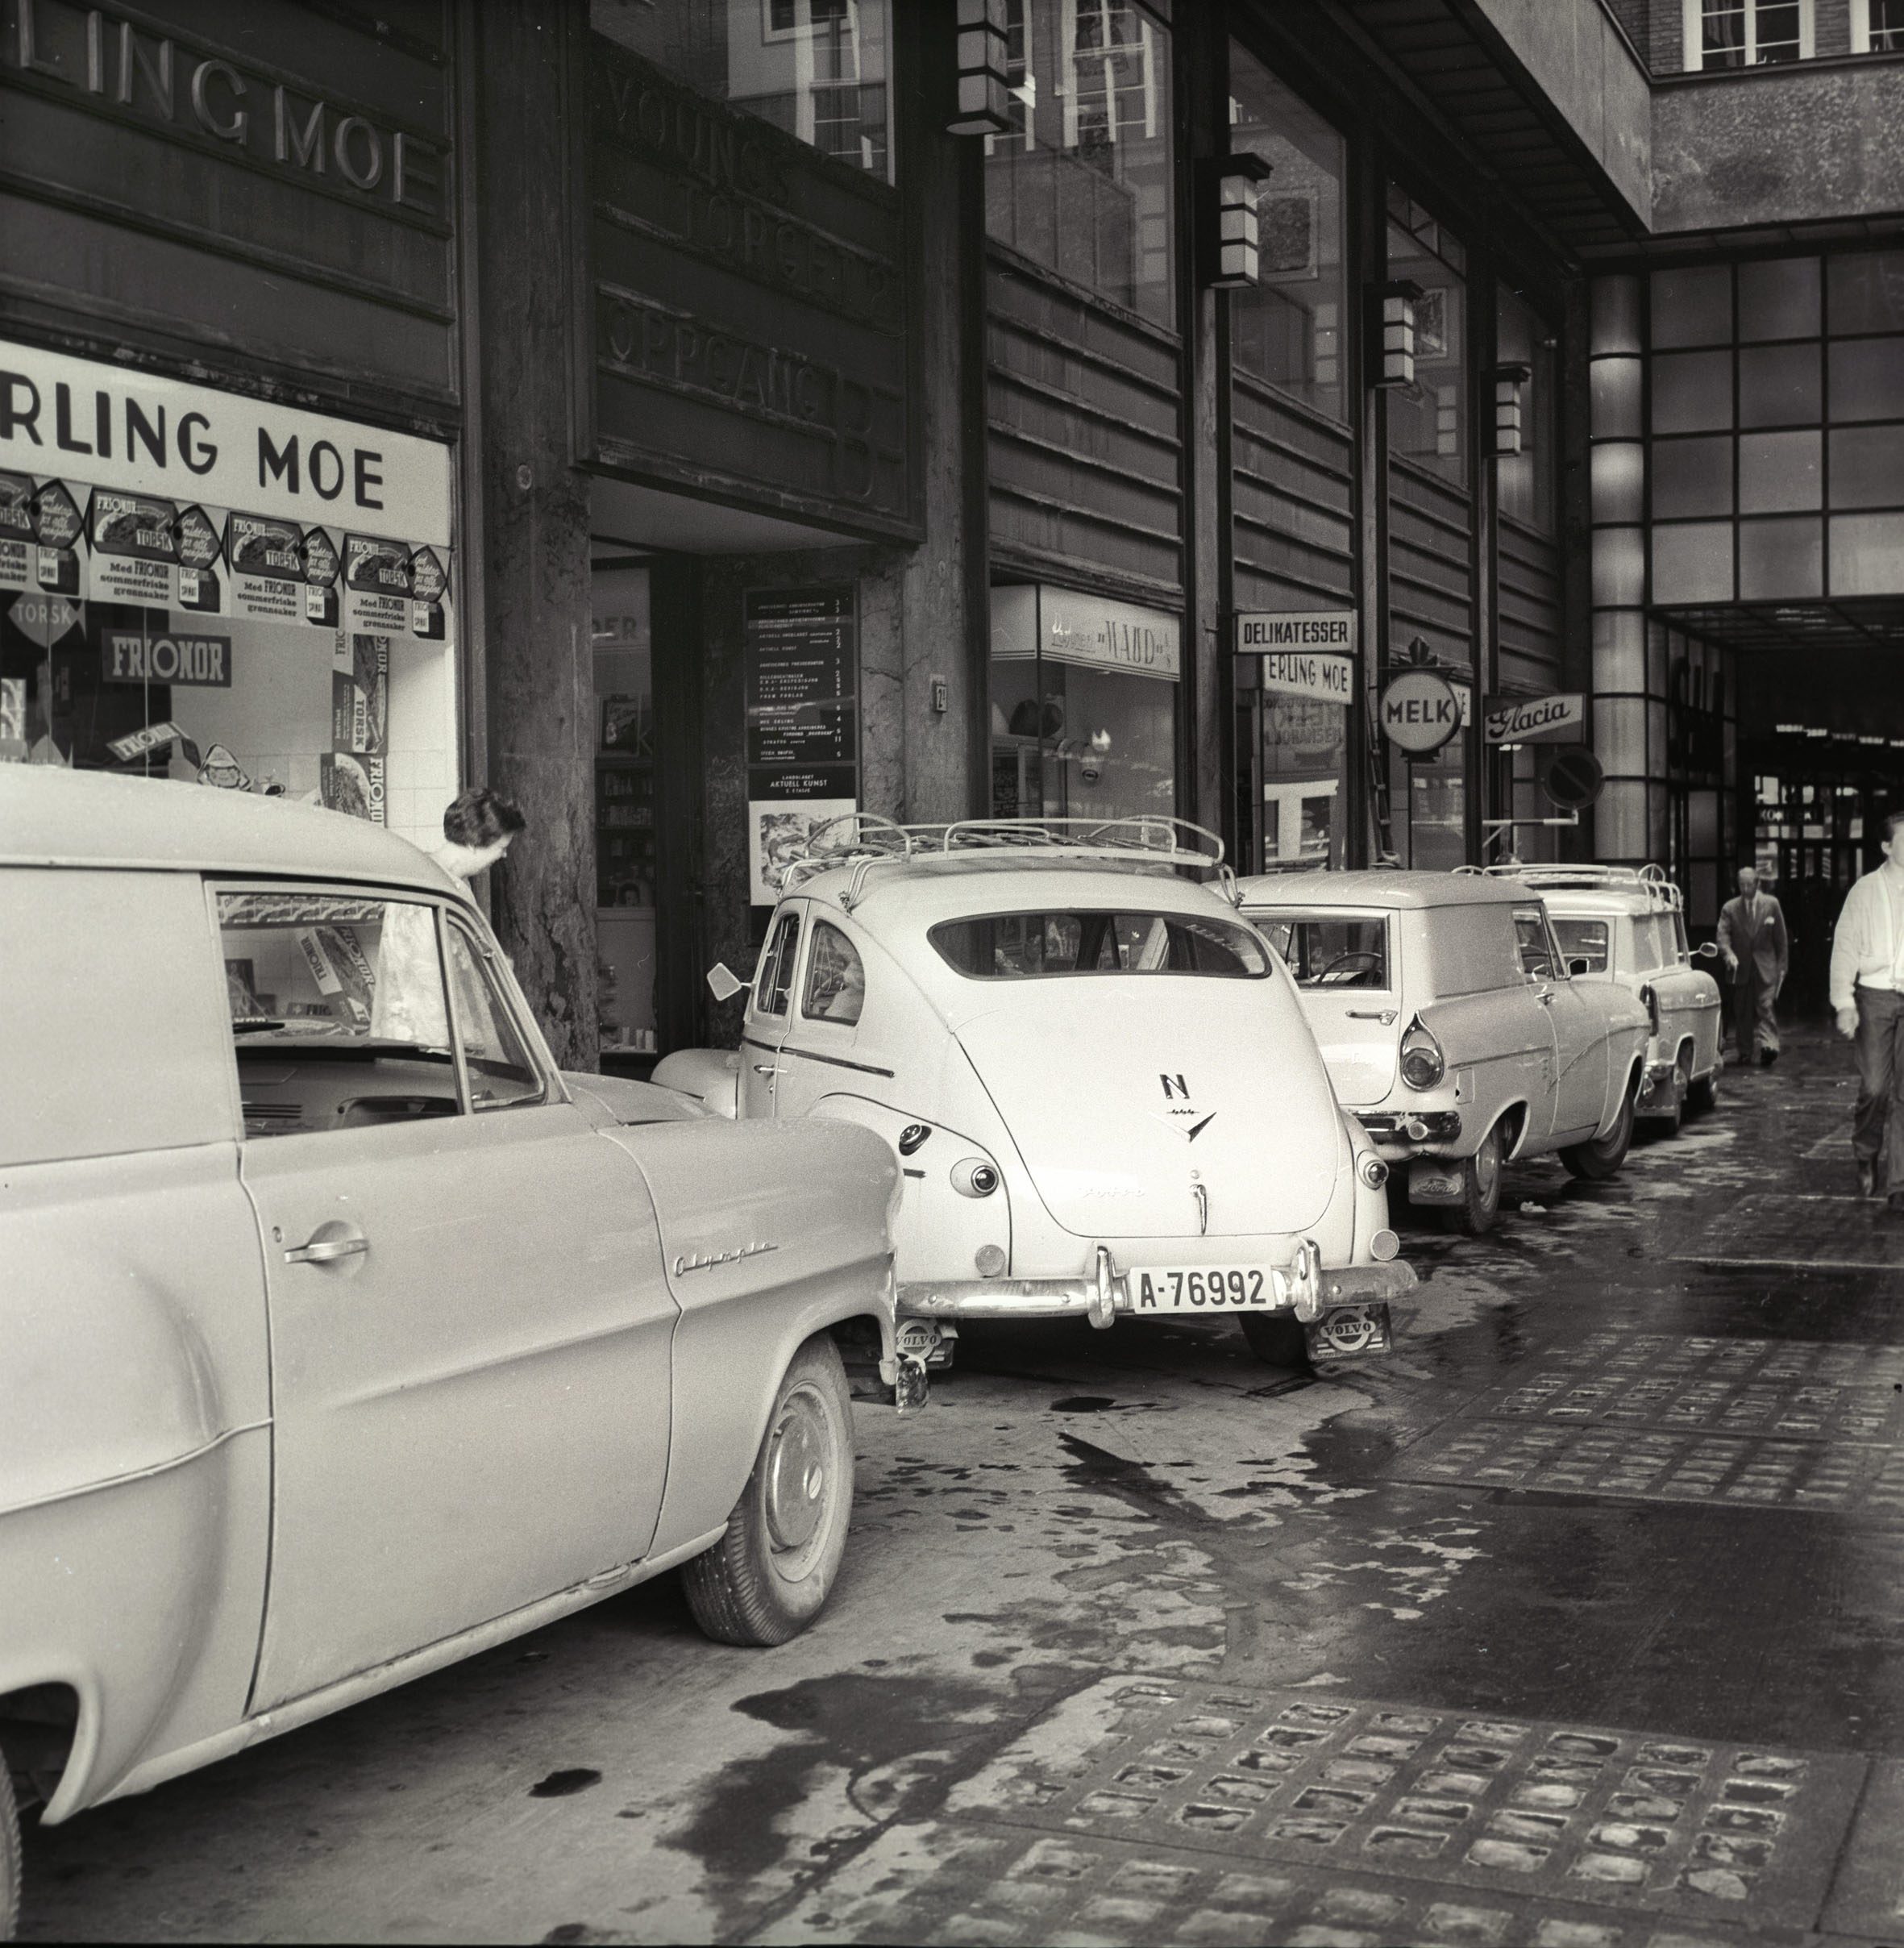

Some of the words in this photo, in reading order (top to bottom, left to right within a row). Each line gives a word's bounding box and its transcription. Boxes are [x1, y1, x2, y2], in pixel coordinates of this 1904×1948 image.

[274, 85, 439, 218] MOE
[258, 426, 384, 510] MOE
[139, 531, 172, 552] TORSK
[110, 563, 131, 573] Med
[135, 560, 168, 579] FRIONOR
[267, 551, 298, 571] TORSK
[100, 575, 169, 590] sommerfriske
[244, 582, 262, 592] Med
[264, 580, 296, 597] FRIONOR
[238, 593, 297, 606] sommerfriske
[16, 603, 73, 626] TORSK
[1244, 621, 1348, 644] DELIKATESSER
[111, 636, 224, 682] FRIONOR
[1270, 654, 1316, 686] ERLING
[1323, 662, 1348, 693] MOE
[355, 699, 366, 747] TORSK
[1386, 699, 1451, 724] MELK
[1488, 701, 1571, 738] Glacia
[1159, 1074, 1189, 1100] N
[1139, 1270, 1266, 1309] A-76992
[896, 1334, 937, 1345] VOLVO
[1324, 1322, 1372, 1336] VOLVO
